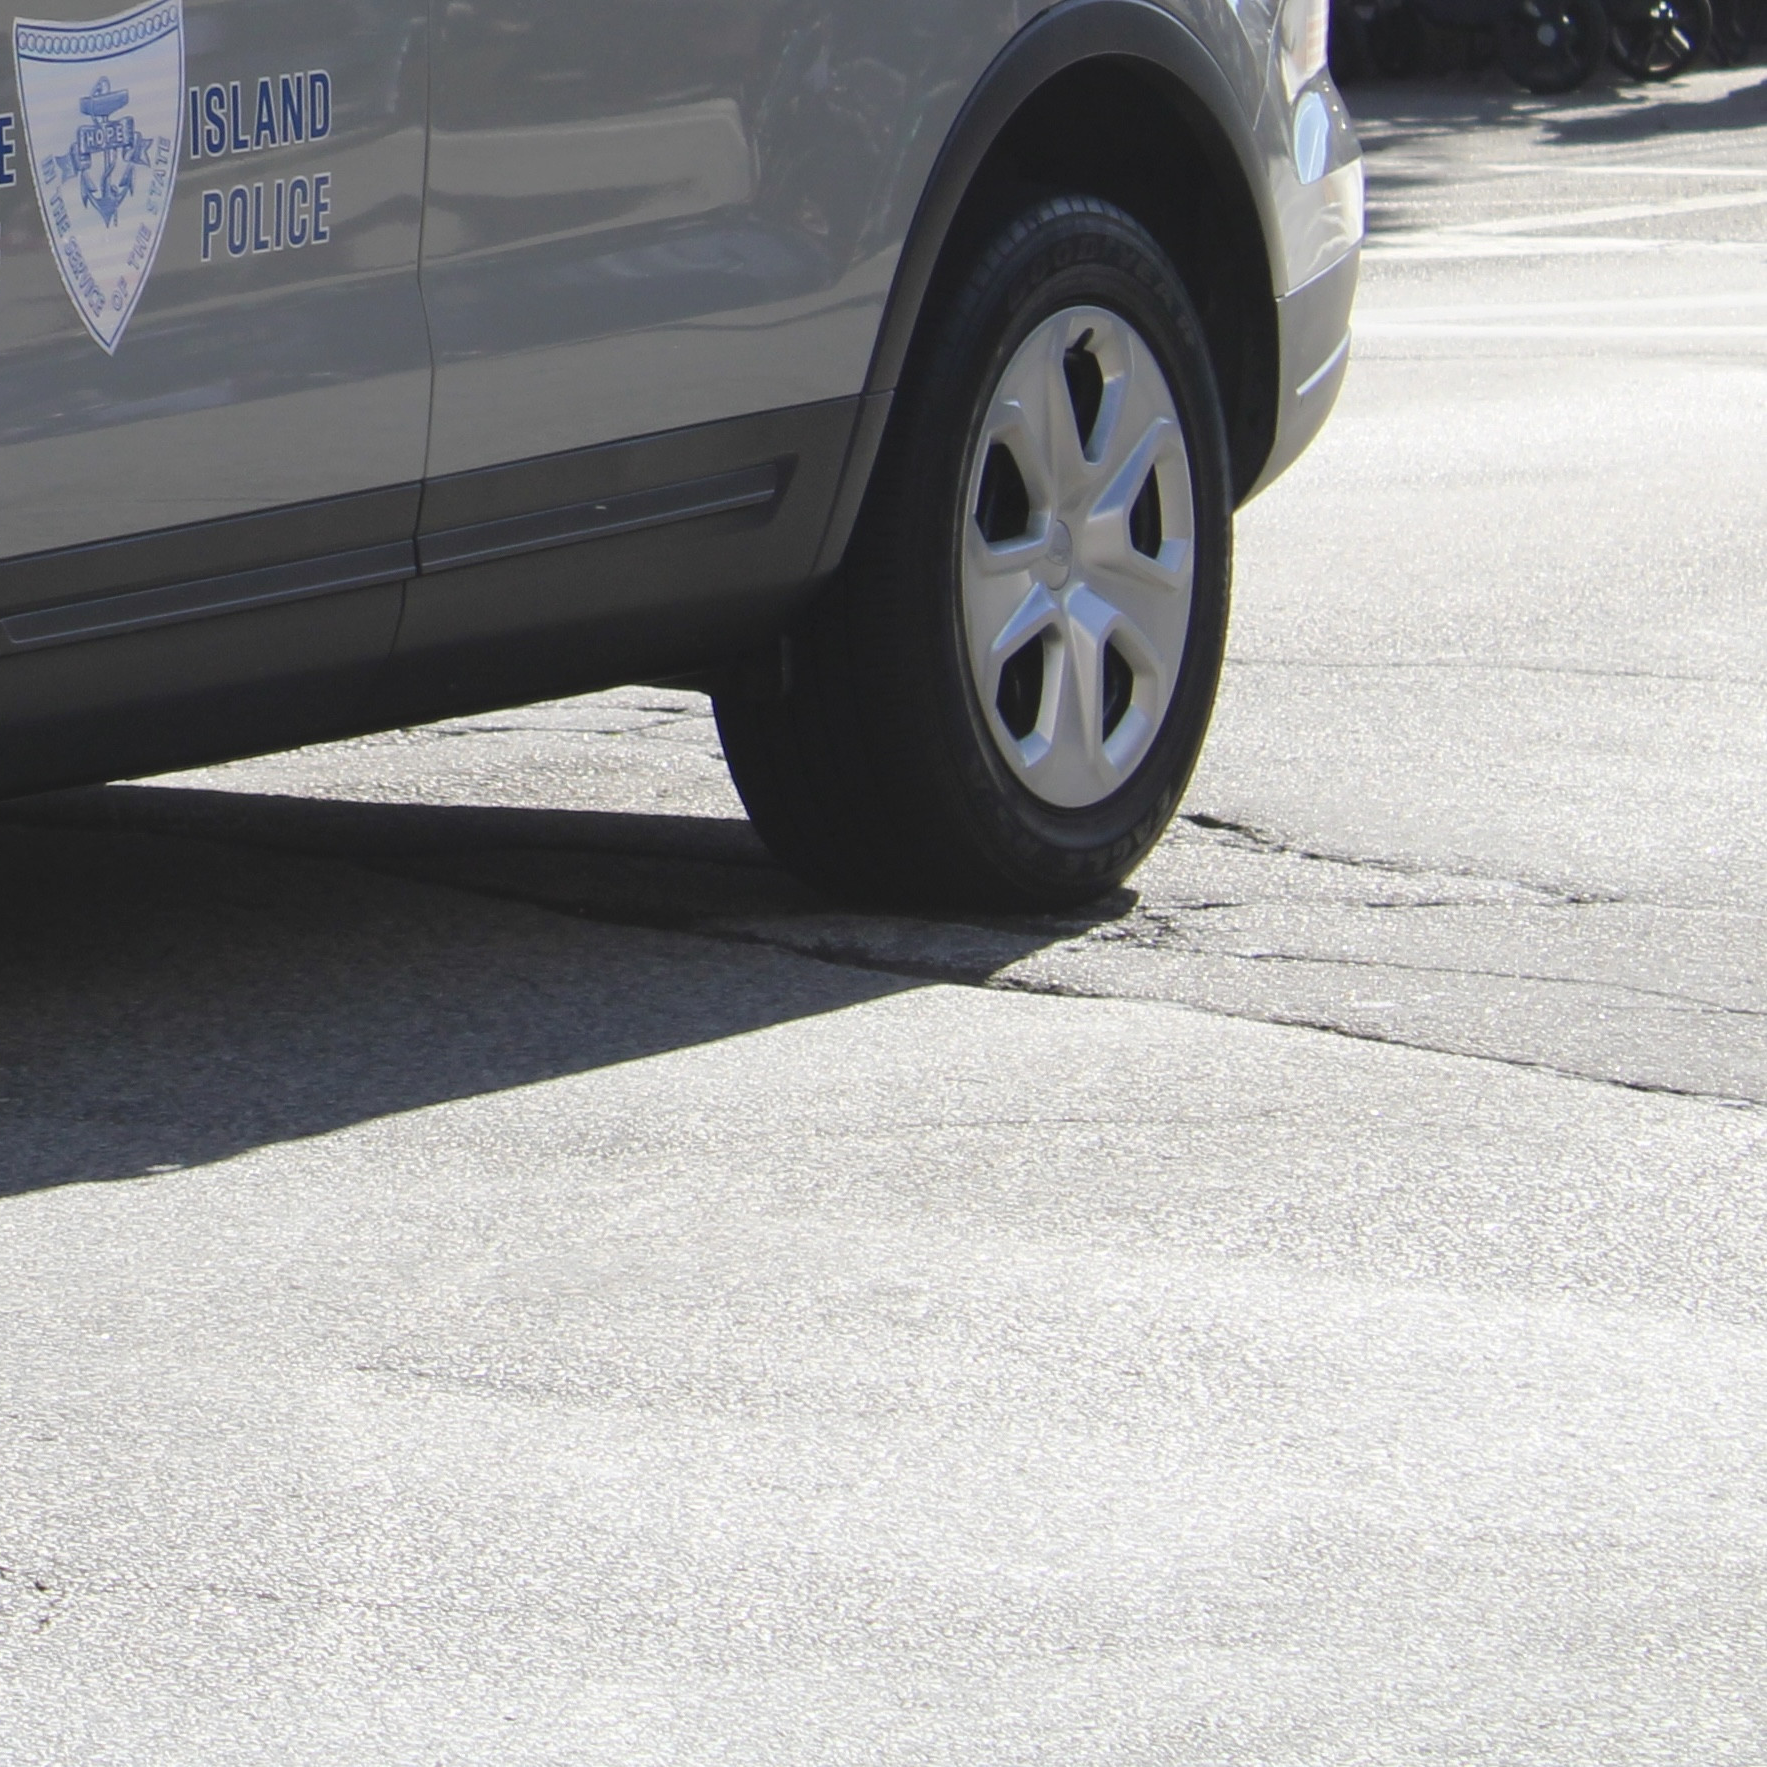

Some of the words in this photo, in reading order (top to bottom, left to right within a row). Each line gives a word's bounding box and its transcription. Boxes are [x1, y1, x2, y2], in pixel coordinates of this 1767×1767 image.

[85, 121, 126, 148] HOPE
[188, 68, 332, 160] ISLAND
[65, 240, 106, 317] SERVICE
[110, 275, 131, 312] OF
[148, 135, 172, 217] STATE
[201, 171, 332, 263] POLICE
